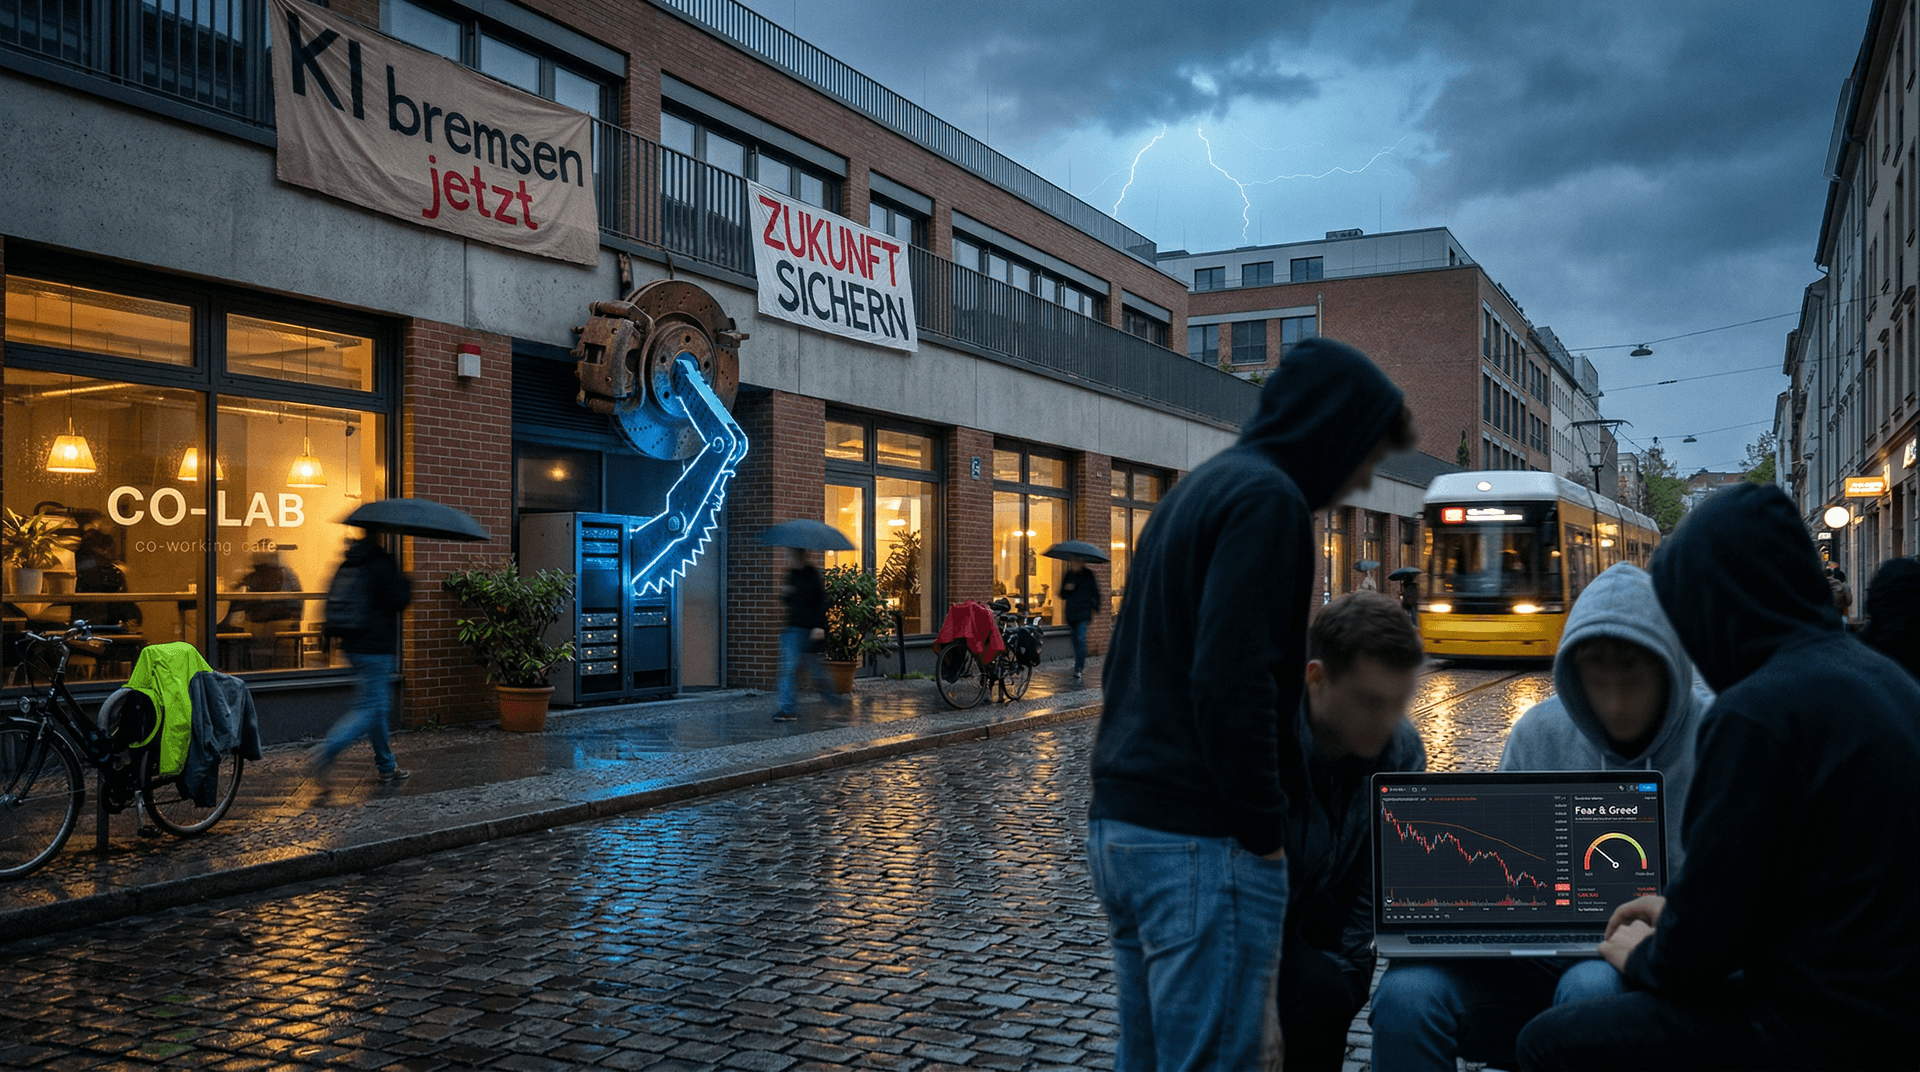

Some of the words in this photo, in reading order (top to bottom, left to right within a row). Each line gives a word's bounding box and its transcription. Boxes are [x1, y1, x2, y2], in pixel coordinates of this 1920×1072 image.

[286, 9, 365, 121] KI
[386, 64, 584, 188] bremsen
[422, 155, 539, 230] jetzt
[758, 194, 900, 287] ZUKUNFT
[776, 259, 909, 341] SICHERN
[107, 485, 305, 527] CO-LAB
[135, 538, 232, 556] co-working
[1575, 806, 1597, 815] Fear
[1599, 806, 1606, 815] &
[1608, 805, 1638, 815] Greed
